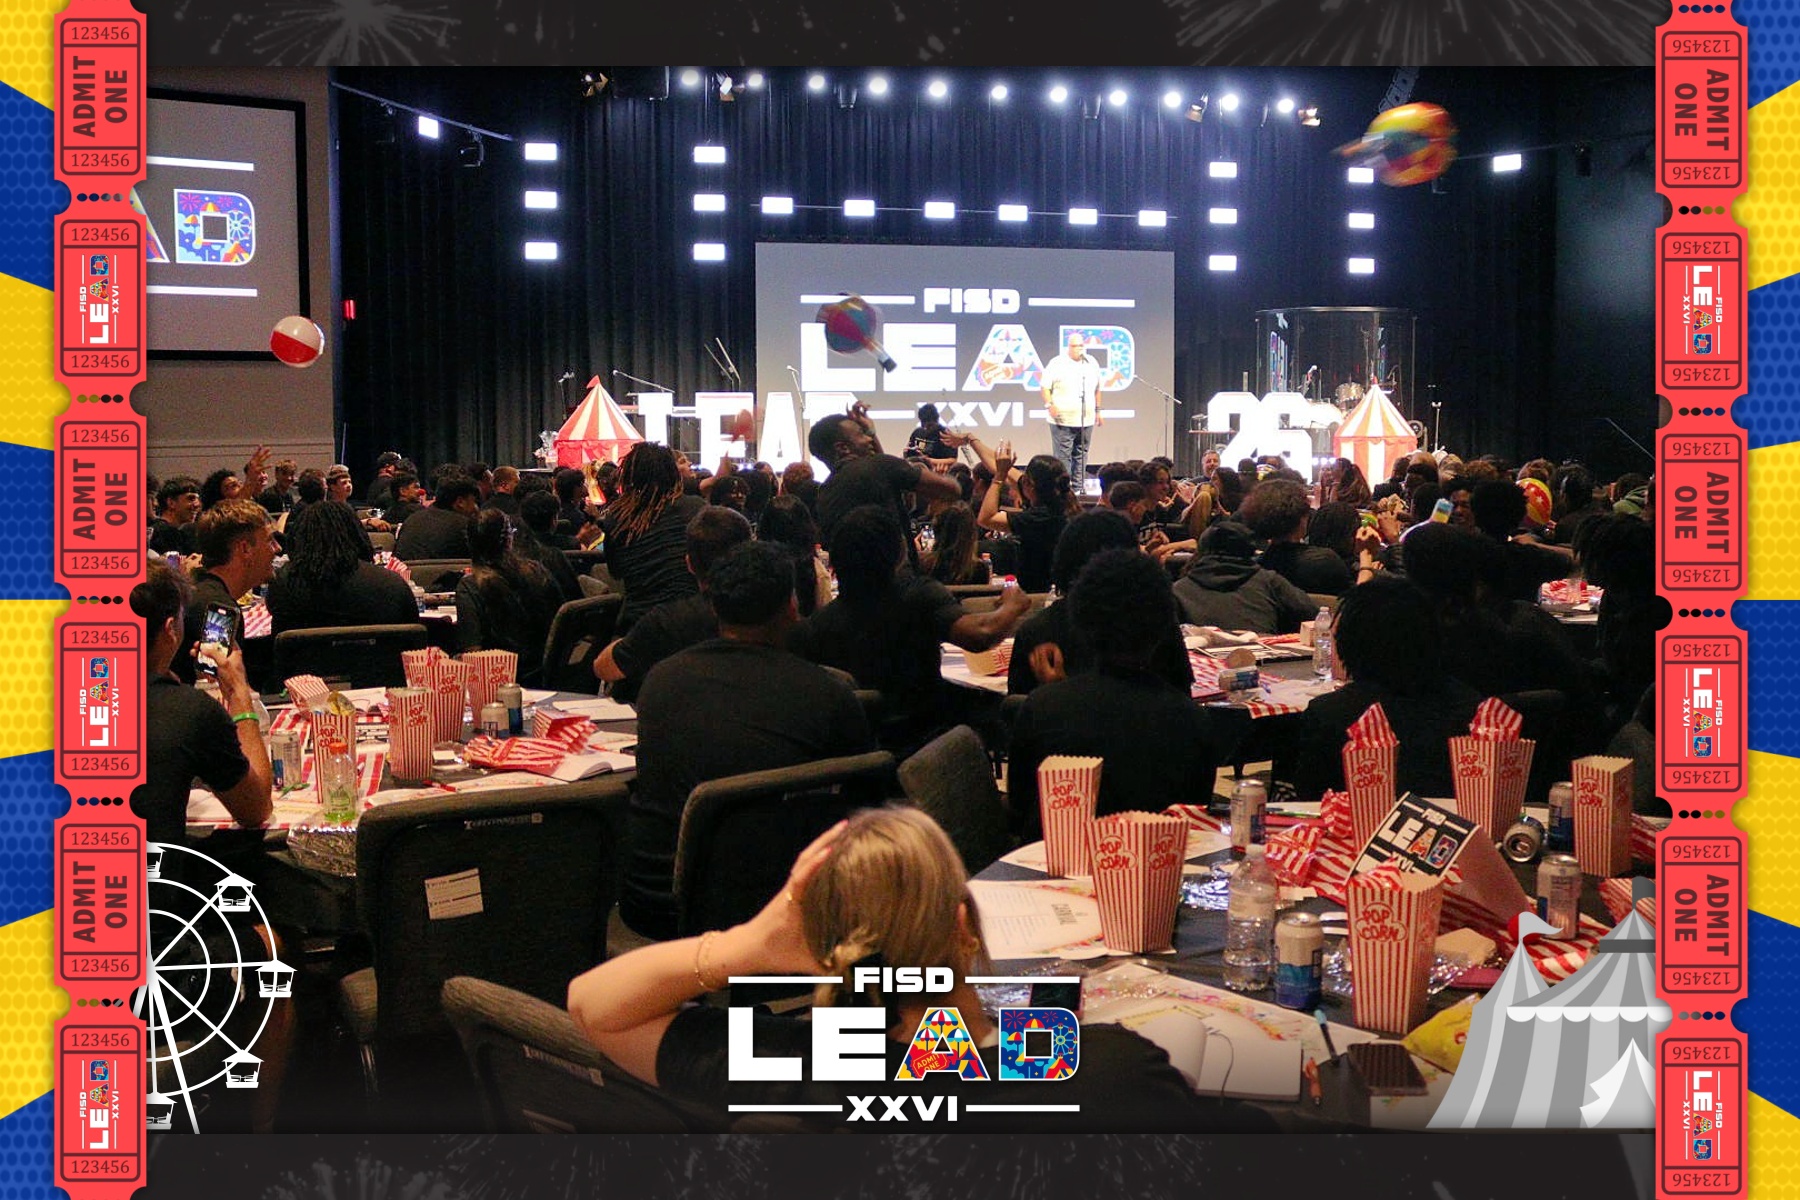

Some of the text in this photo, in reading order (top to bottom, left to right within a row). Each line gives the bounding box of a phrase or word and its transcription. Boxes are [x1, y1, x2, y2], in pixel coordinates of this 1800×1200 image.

[924, 288, 1020, 314] FISD
[800, 323, 1136, 392] LEAD
[319, 738, 340, 748] COR
[1460, 754, 1479, 766] POP
[1356, 762, 1377, 776] POP
[1459, 766, 1484, 778] CORN
[1052, 784, 1074, 798] POP
[1050, 797, 1081, 811] CORN
[1099, 840, 1122, 855] POP
[1377, 811, 1459, 869] LEAD
[1100, 855, 1131, 870] CORN
[1361, 908, 1390, 925] POP
[1361, 925, 1400, 942] CORN
